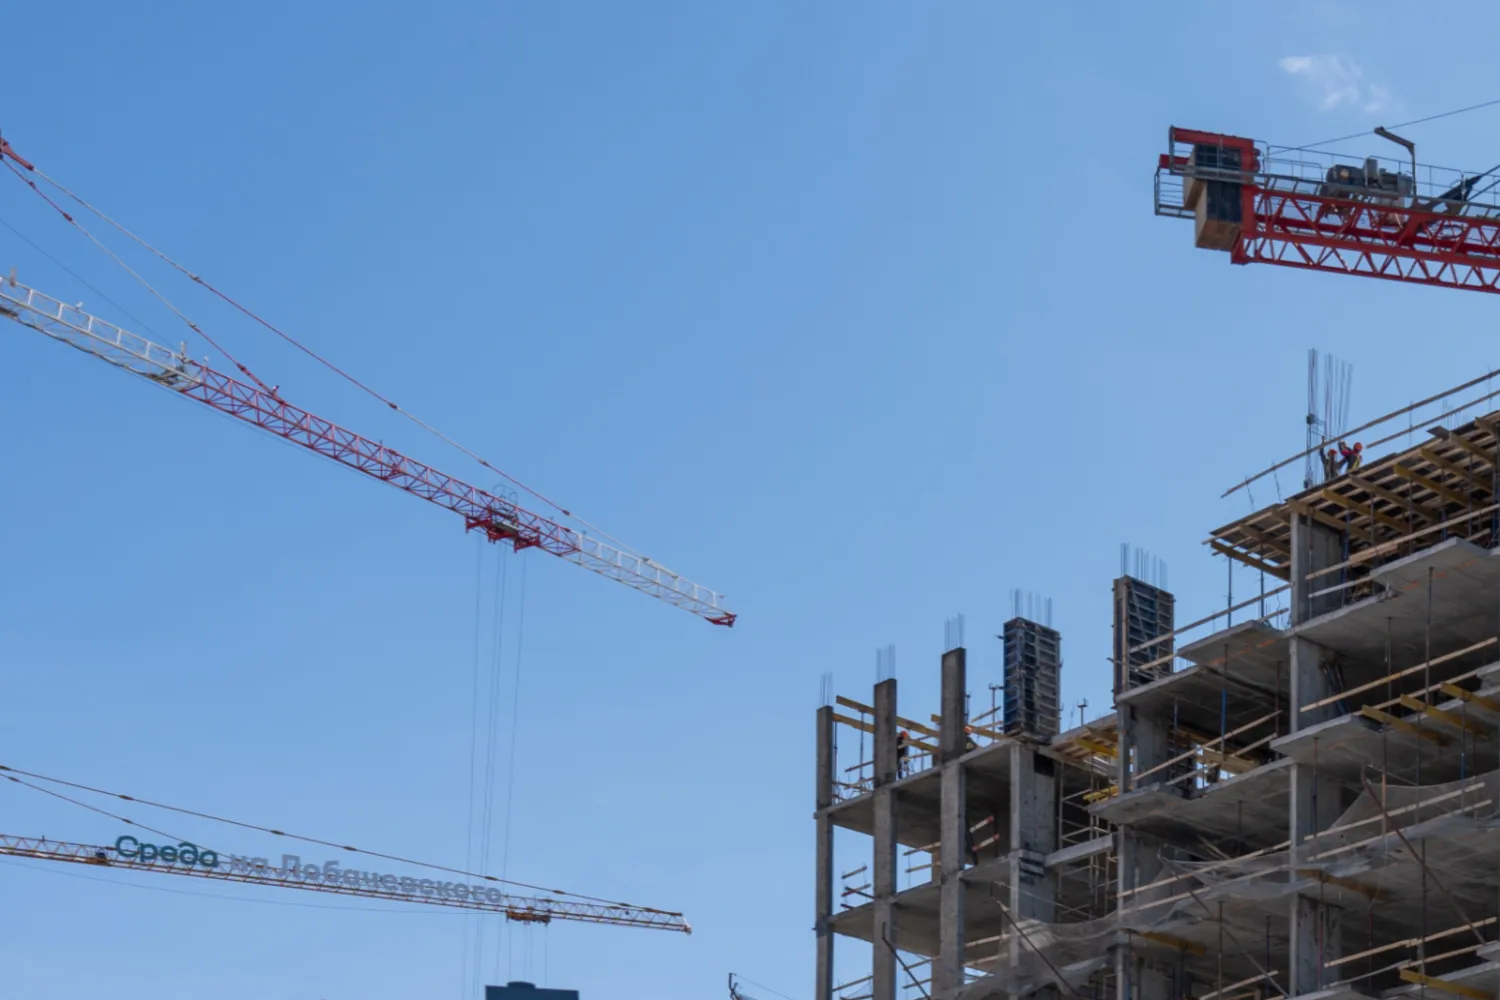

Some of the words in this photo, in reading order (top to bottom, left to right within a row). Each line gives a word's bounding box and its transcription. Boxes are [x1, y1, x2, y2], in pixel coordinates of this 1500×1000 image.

[115, 835, 219, 868] Среда
[229, 853, 269, 875] на
[276, 853, 502, 903] Лобачевского
